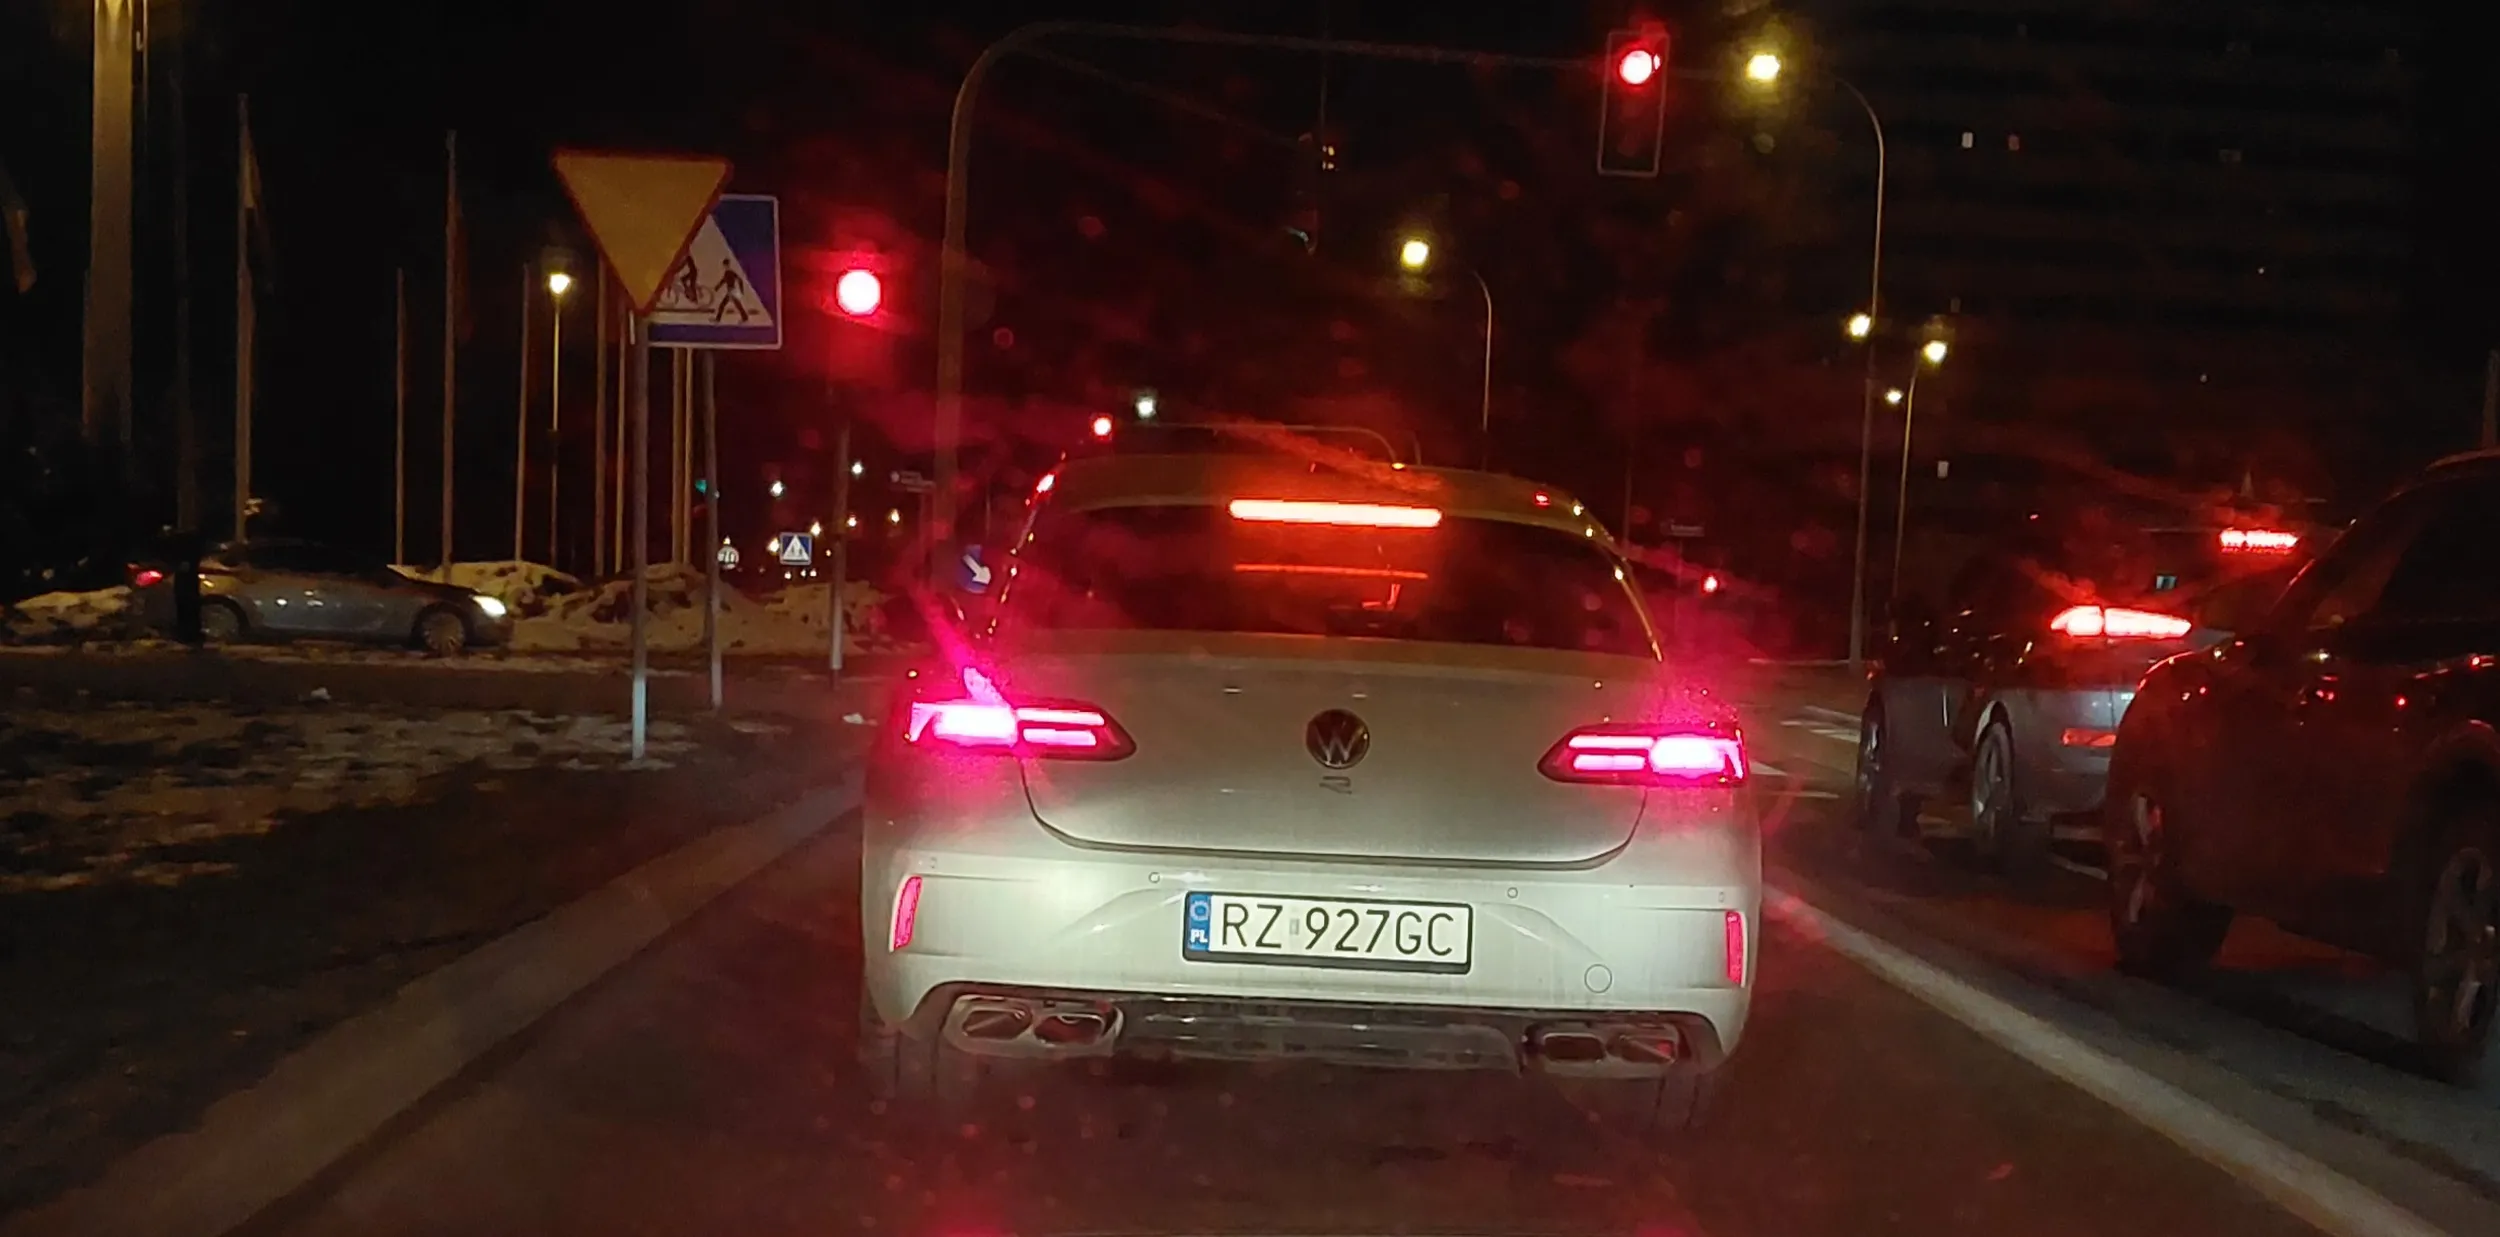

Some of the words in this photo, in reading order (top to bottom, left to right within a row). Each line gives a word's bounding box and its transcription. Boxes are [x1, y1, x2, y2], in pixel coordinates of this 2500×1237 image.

[1191, 928, 1208, 943] PL
[1221, 903, 1283, 948] RZ
[1305, 906, 1454, 956] 927GC
